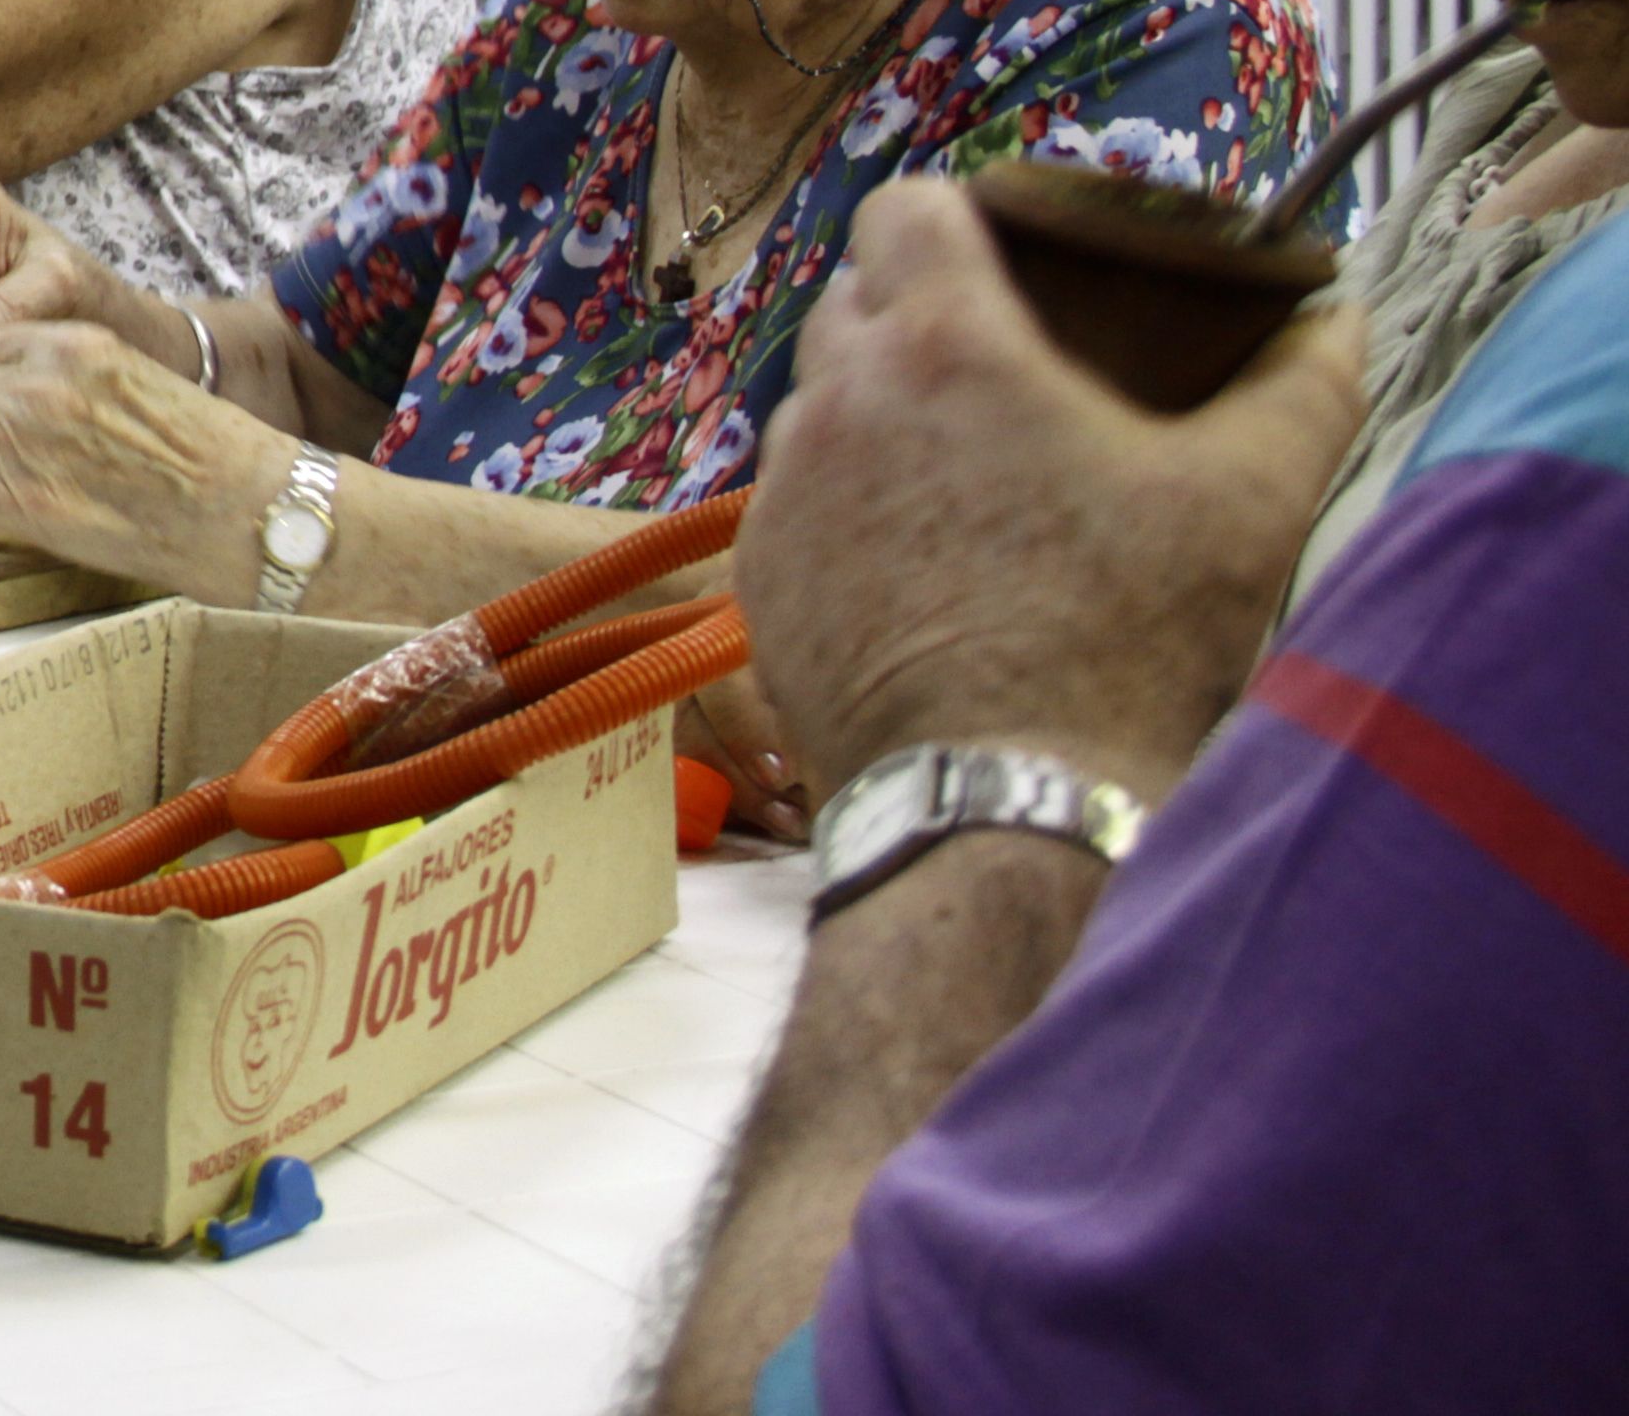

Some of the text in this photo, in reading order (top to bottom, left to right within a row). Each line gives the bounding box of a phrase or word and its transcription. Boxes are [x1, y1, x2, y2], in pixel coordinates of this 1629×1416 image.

[31, 813, 66, 857] TRES
[391, 808, 516, 914] ALFAJORES
[327, 859, 538, 1060] Jorgito
[20, 1072, 111, 1159] 14
[187, 1084, 348, 1188] INDUSTRIA ARGENTINA
